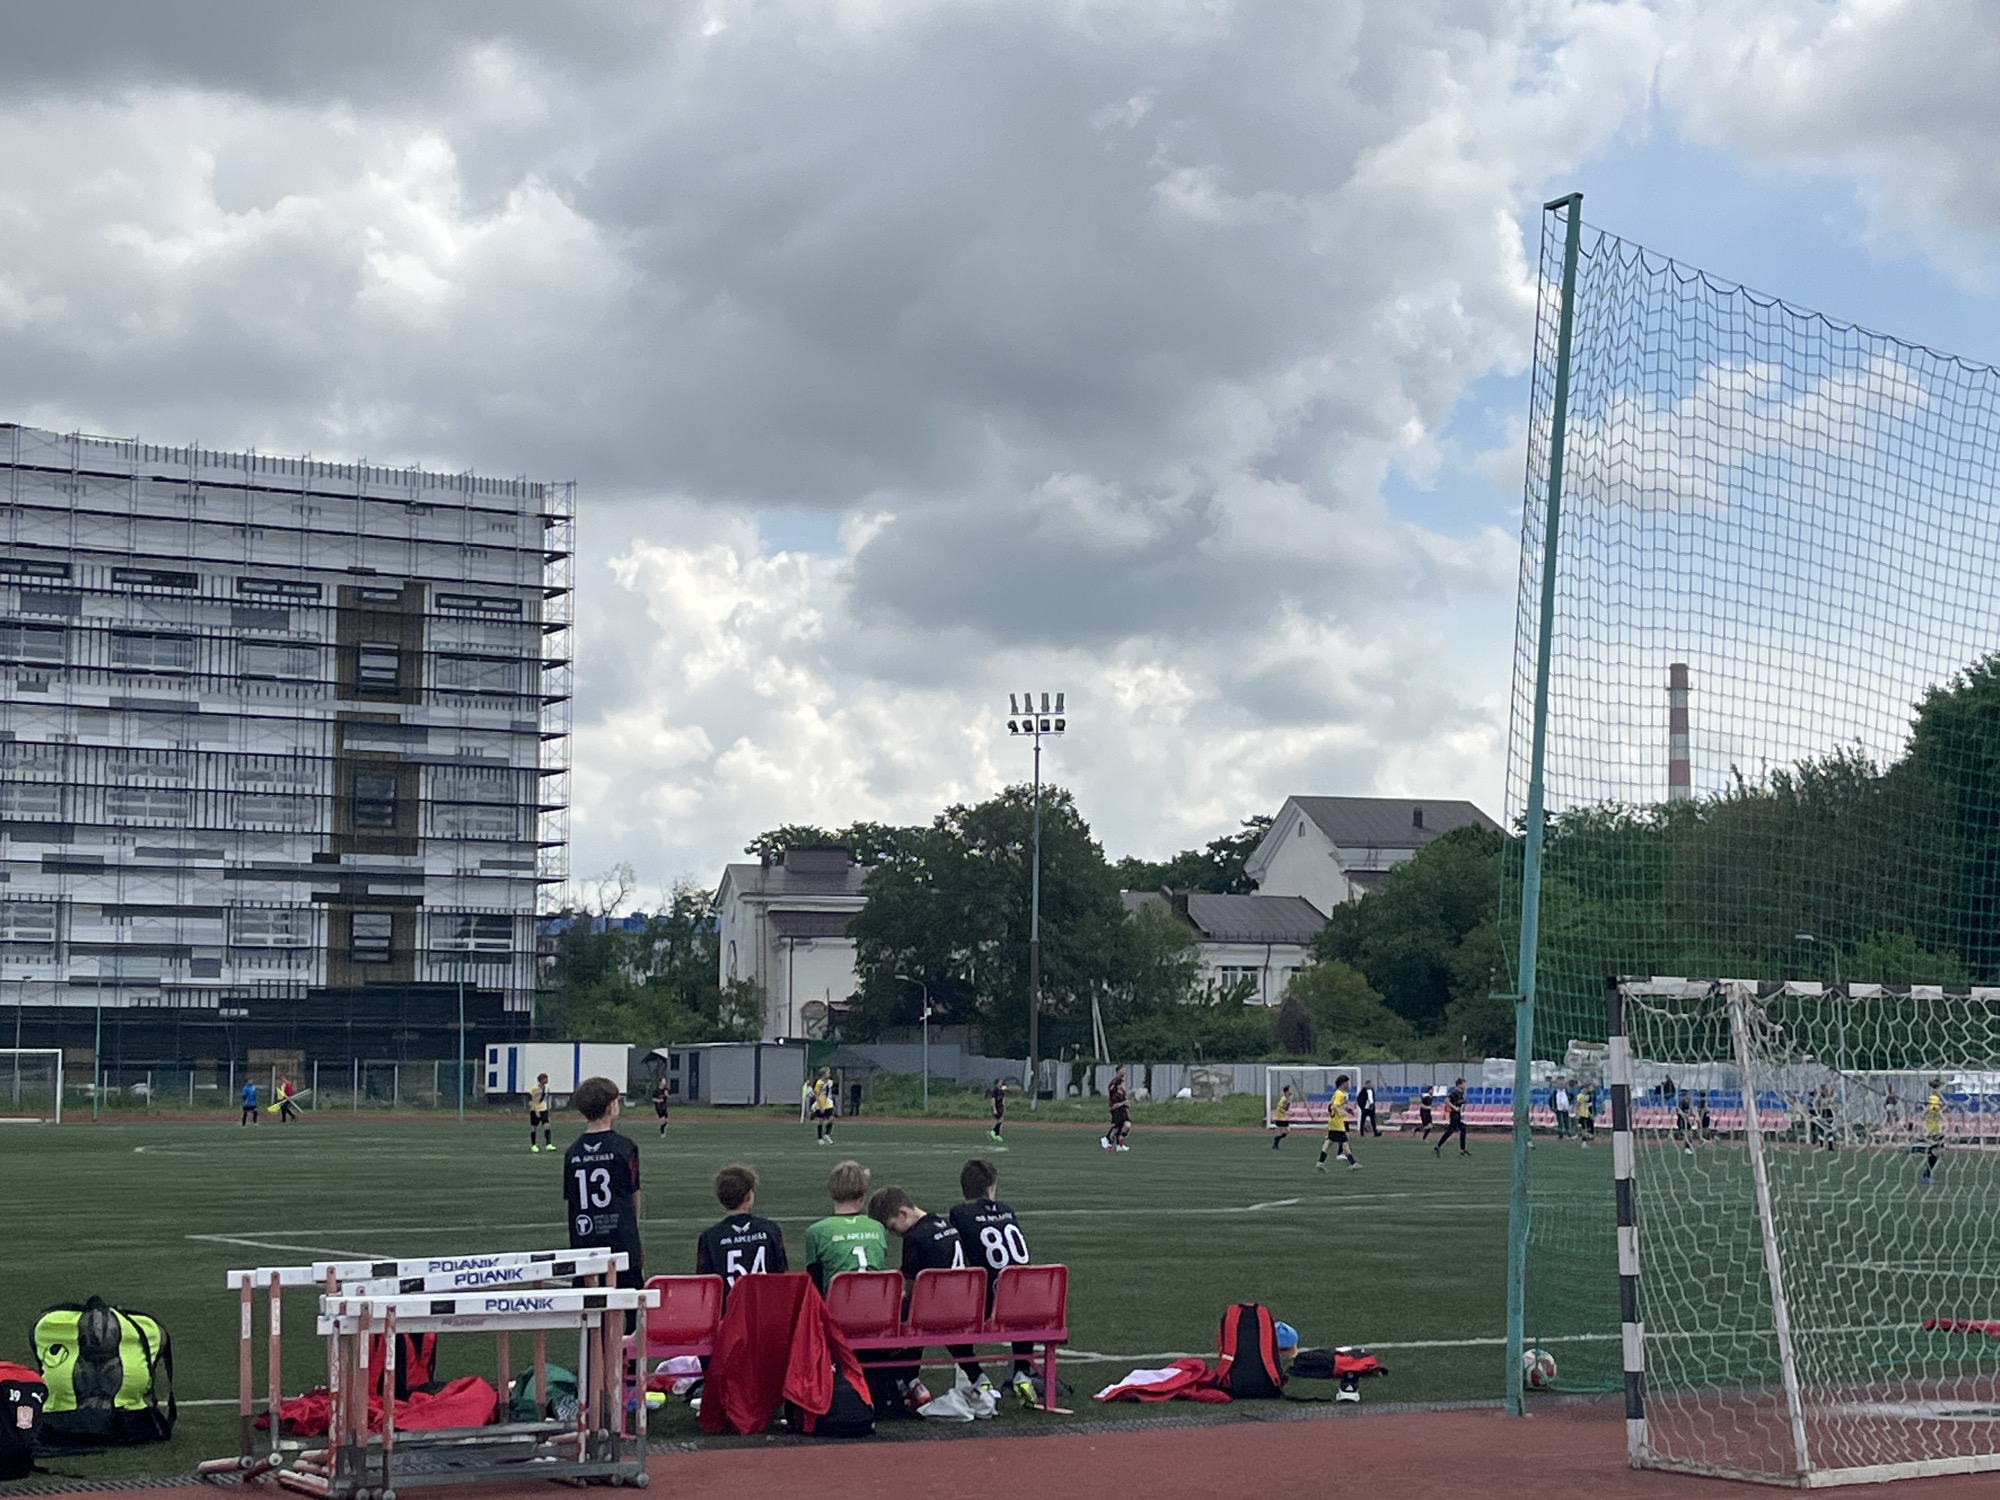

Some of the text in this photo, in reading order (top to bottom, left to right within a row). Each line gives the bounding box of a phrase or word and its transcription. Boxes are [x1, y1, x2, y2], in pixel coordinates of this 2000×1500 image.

[574, 1167, 612, 1210] 13
[851, 1245, 868, 1273] 1
[951, 1240, 966, 1270] 4
[980, 1223, 1029, 1269] 80
[428, 1257, 500, 1273] POLANIK
[454, 1267, 523, 1286] POLANIK
[726, 1244, 768, 1287] 54
[484, 1297, 554, 1313] POLANIK
